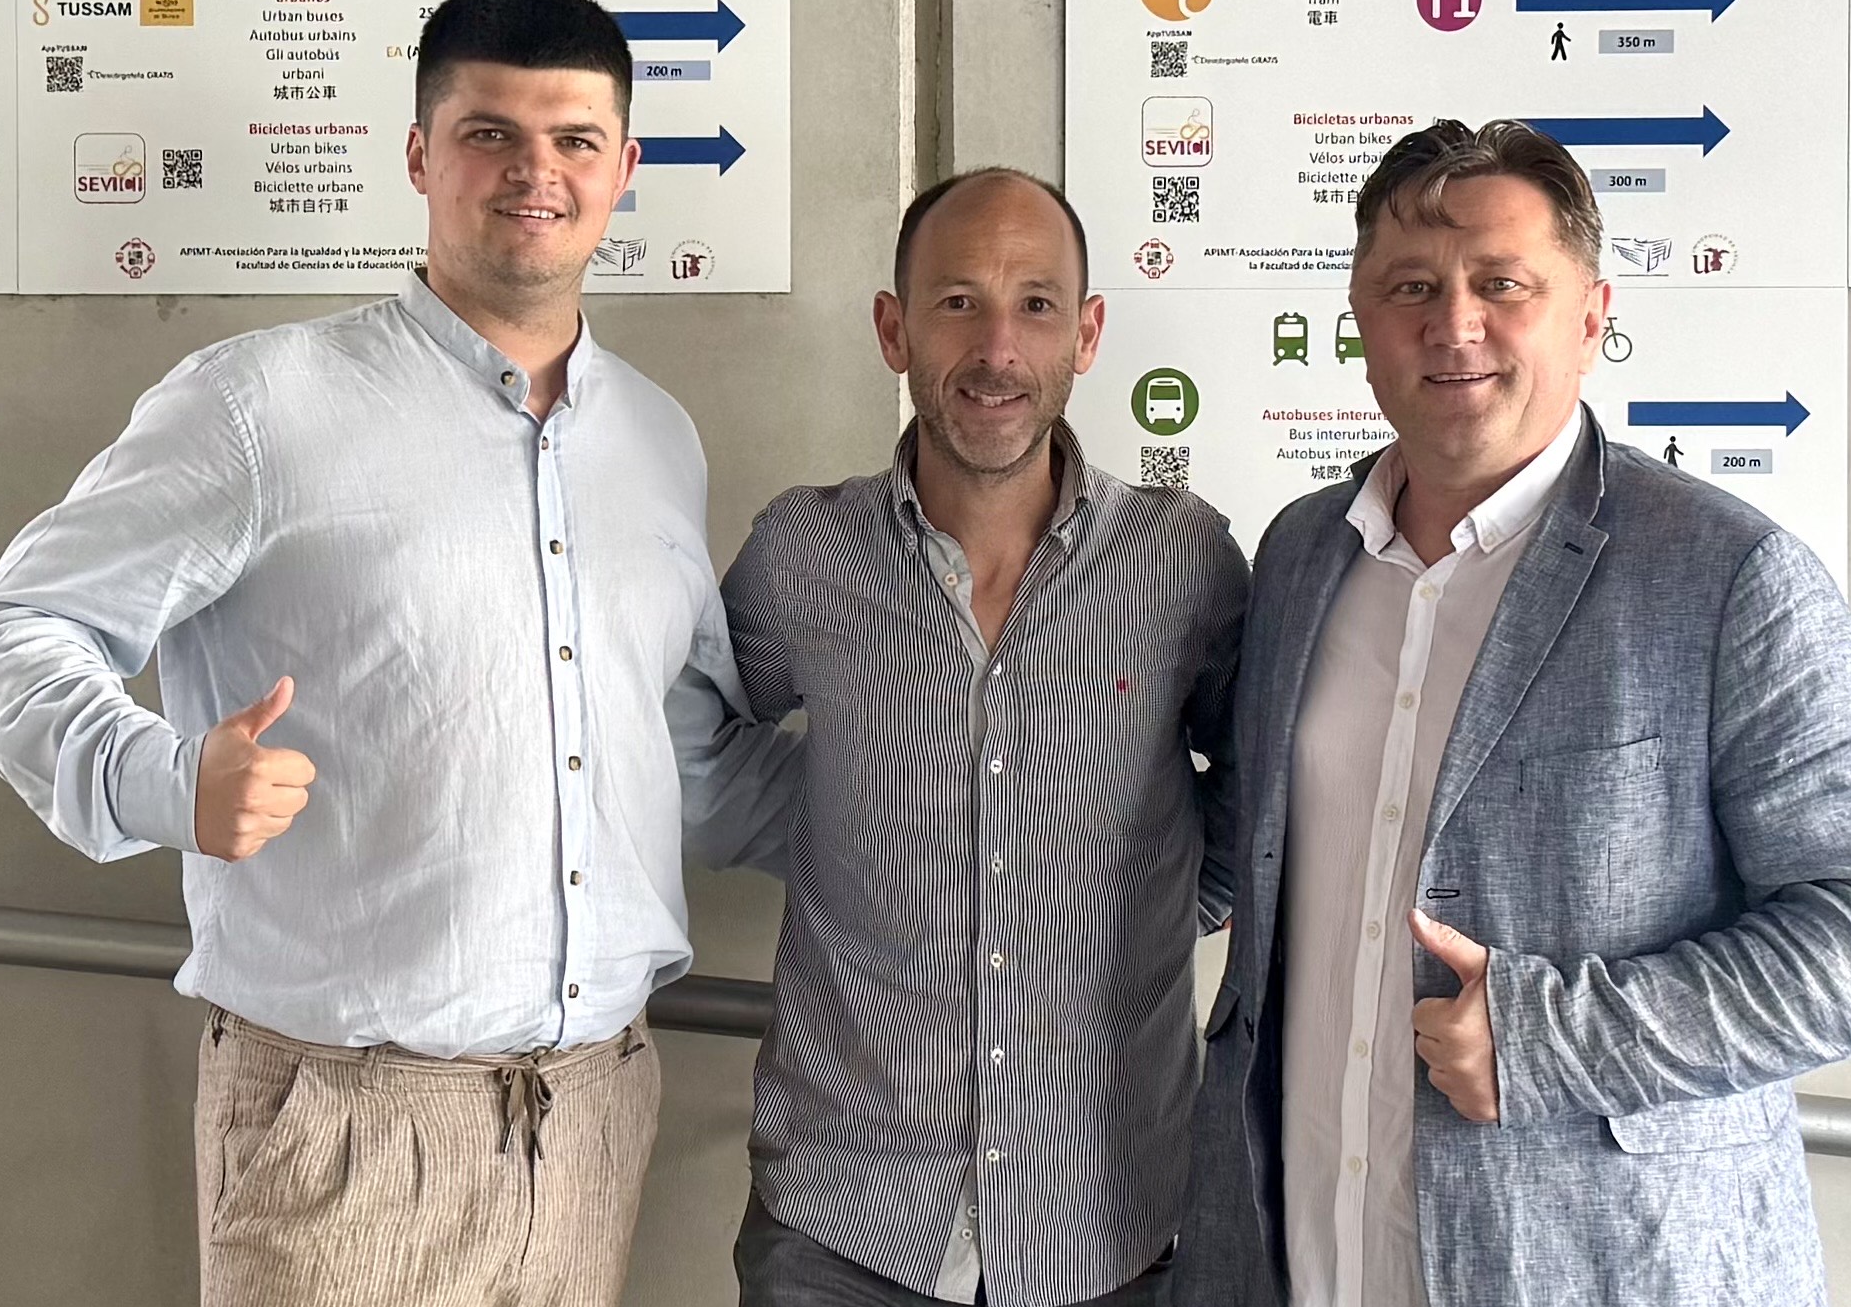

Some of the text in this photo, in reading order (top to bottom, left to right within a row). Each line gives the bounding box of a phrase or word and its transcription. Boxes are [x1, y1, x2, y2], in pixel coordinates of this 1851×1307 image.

[56, 1, 132, 17] TUSSAM
[262, 9, 344, 23] Urban buses
[249, 28, 357, 42] Autobus urbains
[1617, 36, 1656, 48] 350 m
[265, 48, 284, 61] Gli
[282, 67, 324, 80] urbani
[646, 65, 683, 77] 200 m
[1293, 112, 1414, 126] Bicicletas urbanas
[249, 122, 369, 135] Bicicletas urbanas
[1314, 131, 1392, 145] Urban bikes
[270, 141, 348, 155] Urban bikes
[1309, 151, 1383, 164] Vélos urbai
[265, 161, 353, 174] Vélos urbains
[1298, 171, 1358, 184] Biciclette
[1609, 175, 1647, 187] 300 m
[254, 180, 364, 193] Biciclette urbane
[1316, 261, 1353, 271] Ciencia
[1262, 409, 1387, 421] Autobuses interur
[1289, 428, 1396, 441] Bus interurbains
[1276, 448, 1331, 460] Autobus
